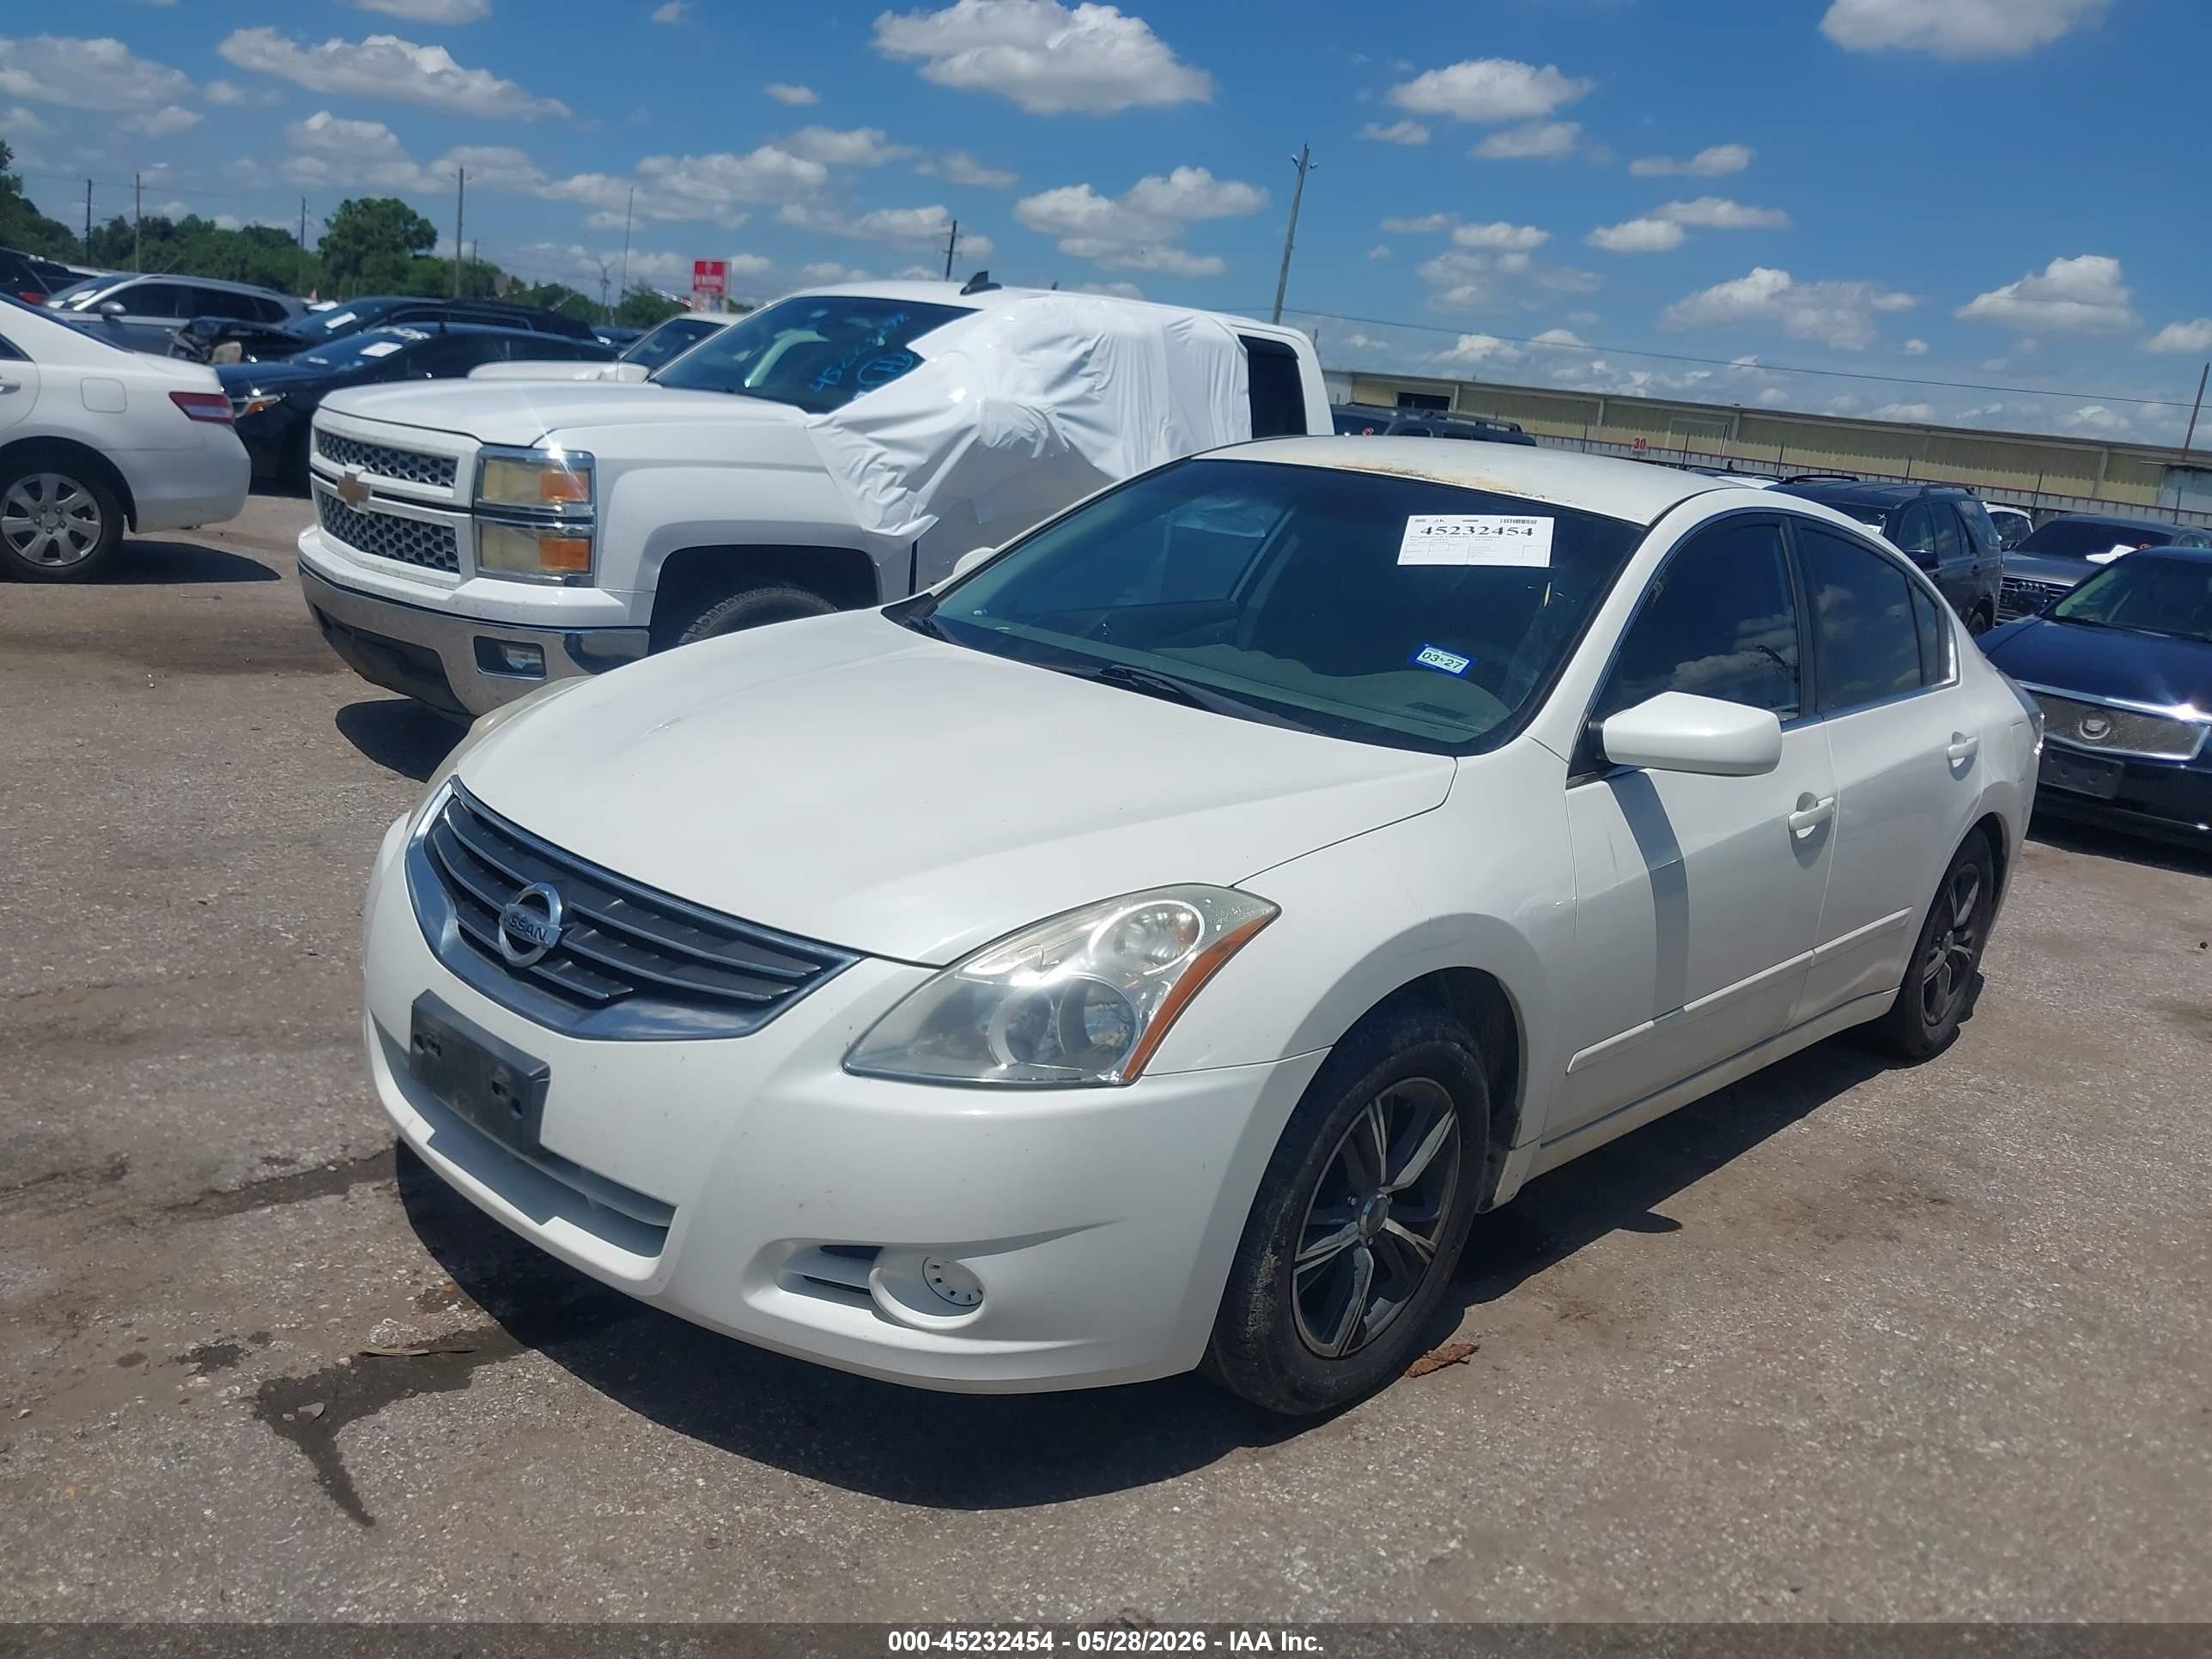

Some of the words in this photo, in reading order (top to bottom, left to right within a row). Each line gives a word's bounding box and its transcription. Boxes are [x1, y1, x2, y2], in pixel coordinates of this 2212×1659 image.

[1634, 437, 1647, 450] 30
[1420, 526, 1534, 537] 45232454
[1421, 652, 1440, 662] 03
[1443, 659, 1464, 669] 27
[504, 912, 548, 942] SSAN
